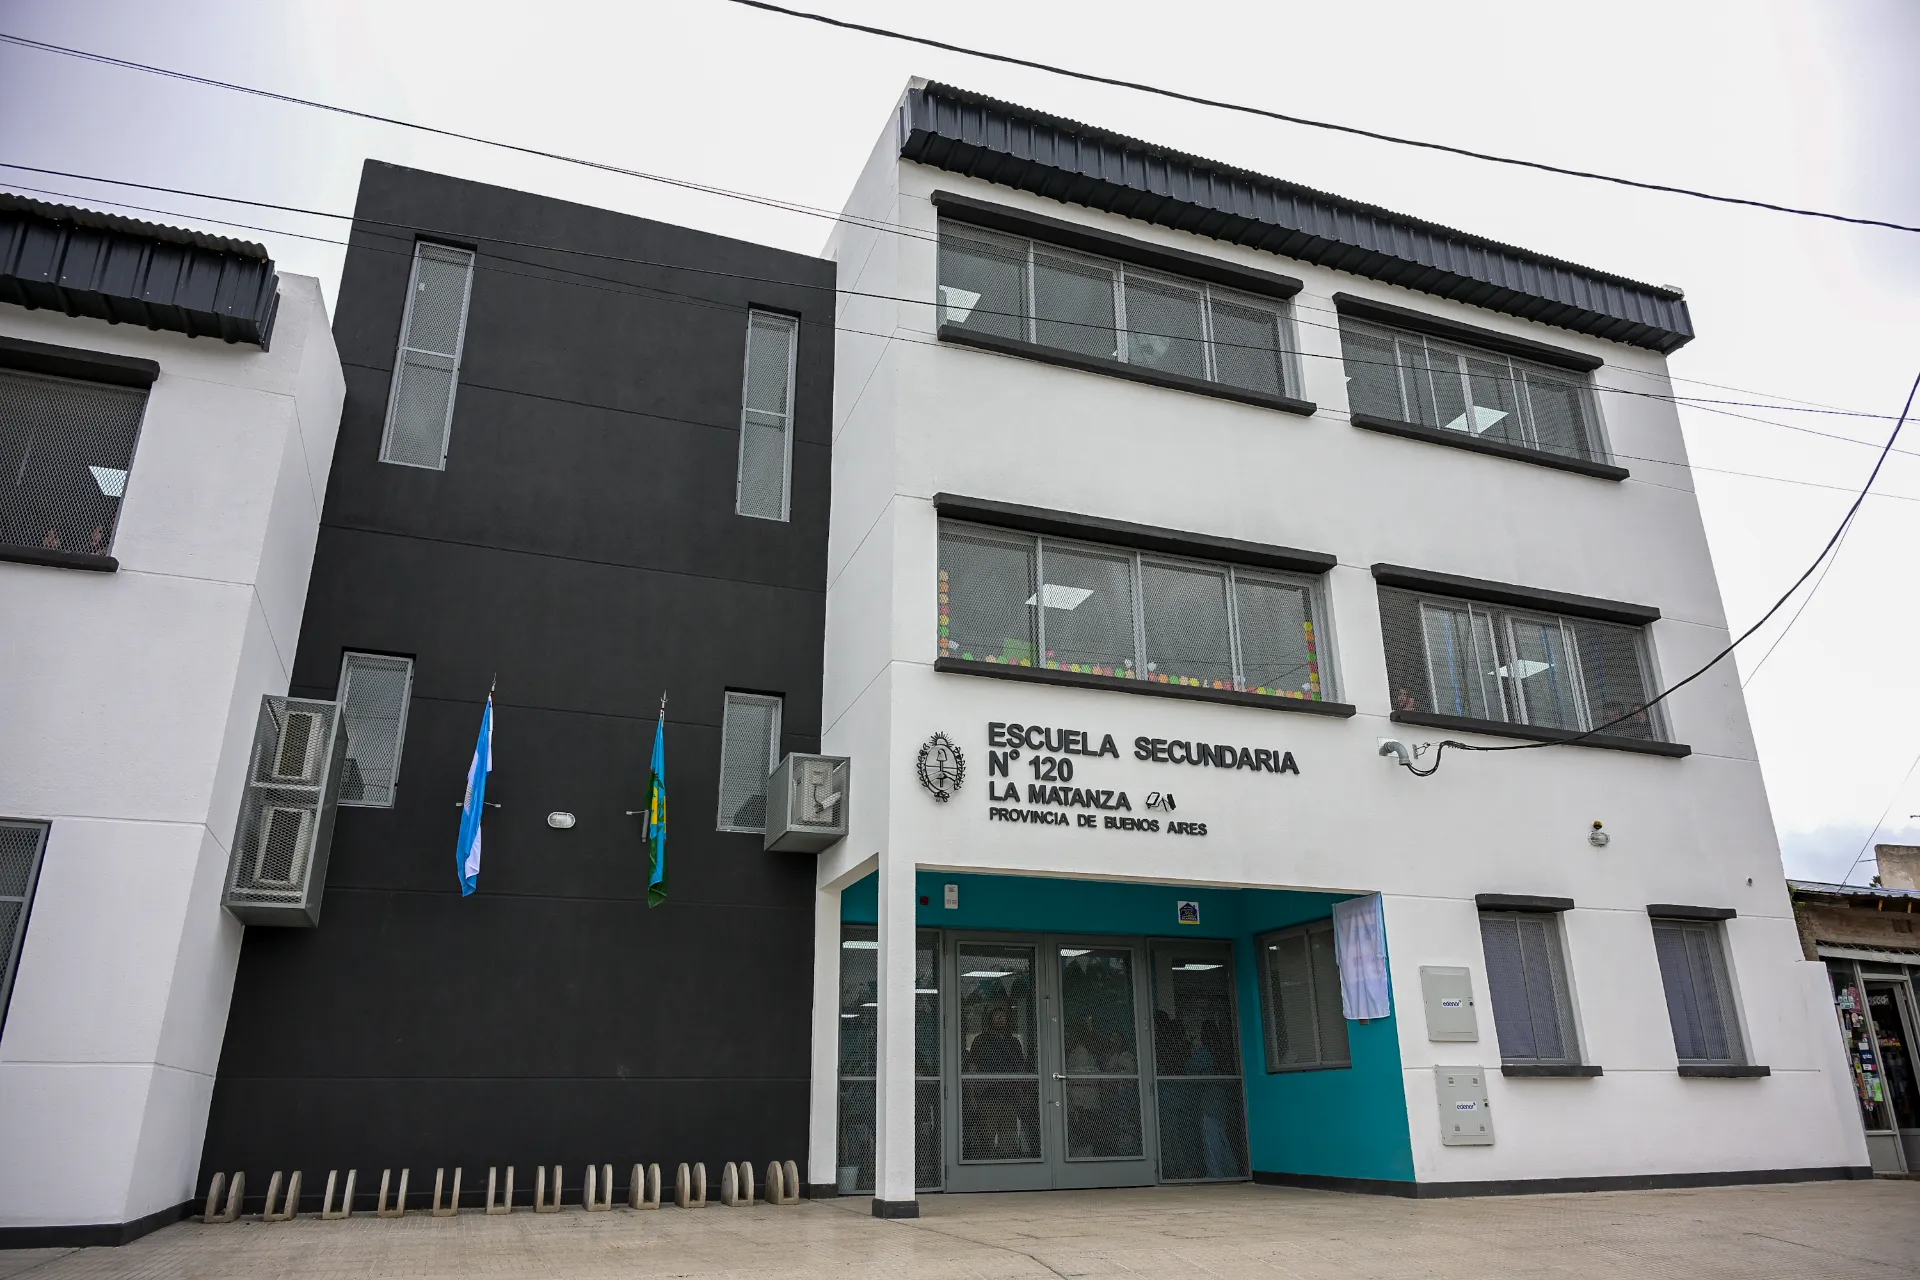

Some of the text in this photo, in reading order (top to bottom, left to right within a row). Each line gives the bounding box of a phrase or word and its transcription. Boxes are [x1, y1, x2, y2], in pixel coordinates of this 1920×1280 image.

[988, 721, 1301, 775] ESCUELA SECUNDARIA
[1028, 755, 1074, 783] 120
[988, 780, 1133, 812] LA MATANZA
[989, 806, 1208, 837] PROVINCIA DE BUENOS AIRES
